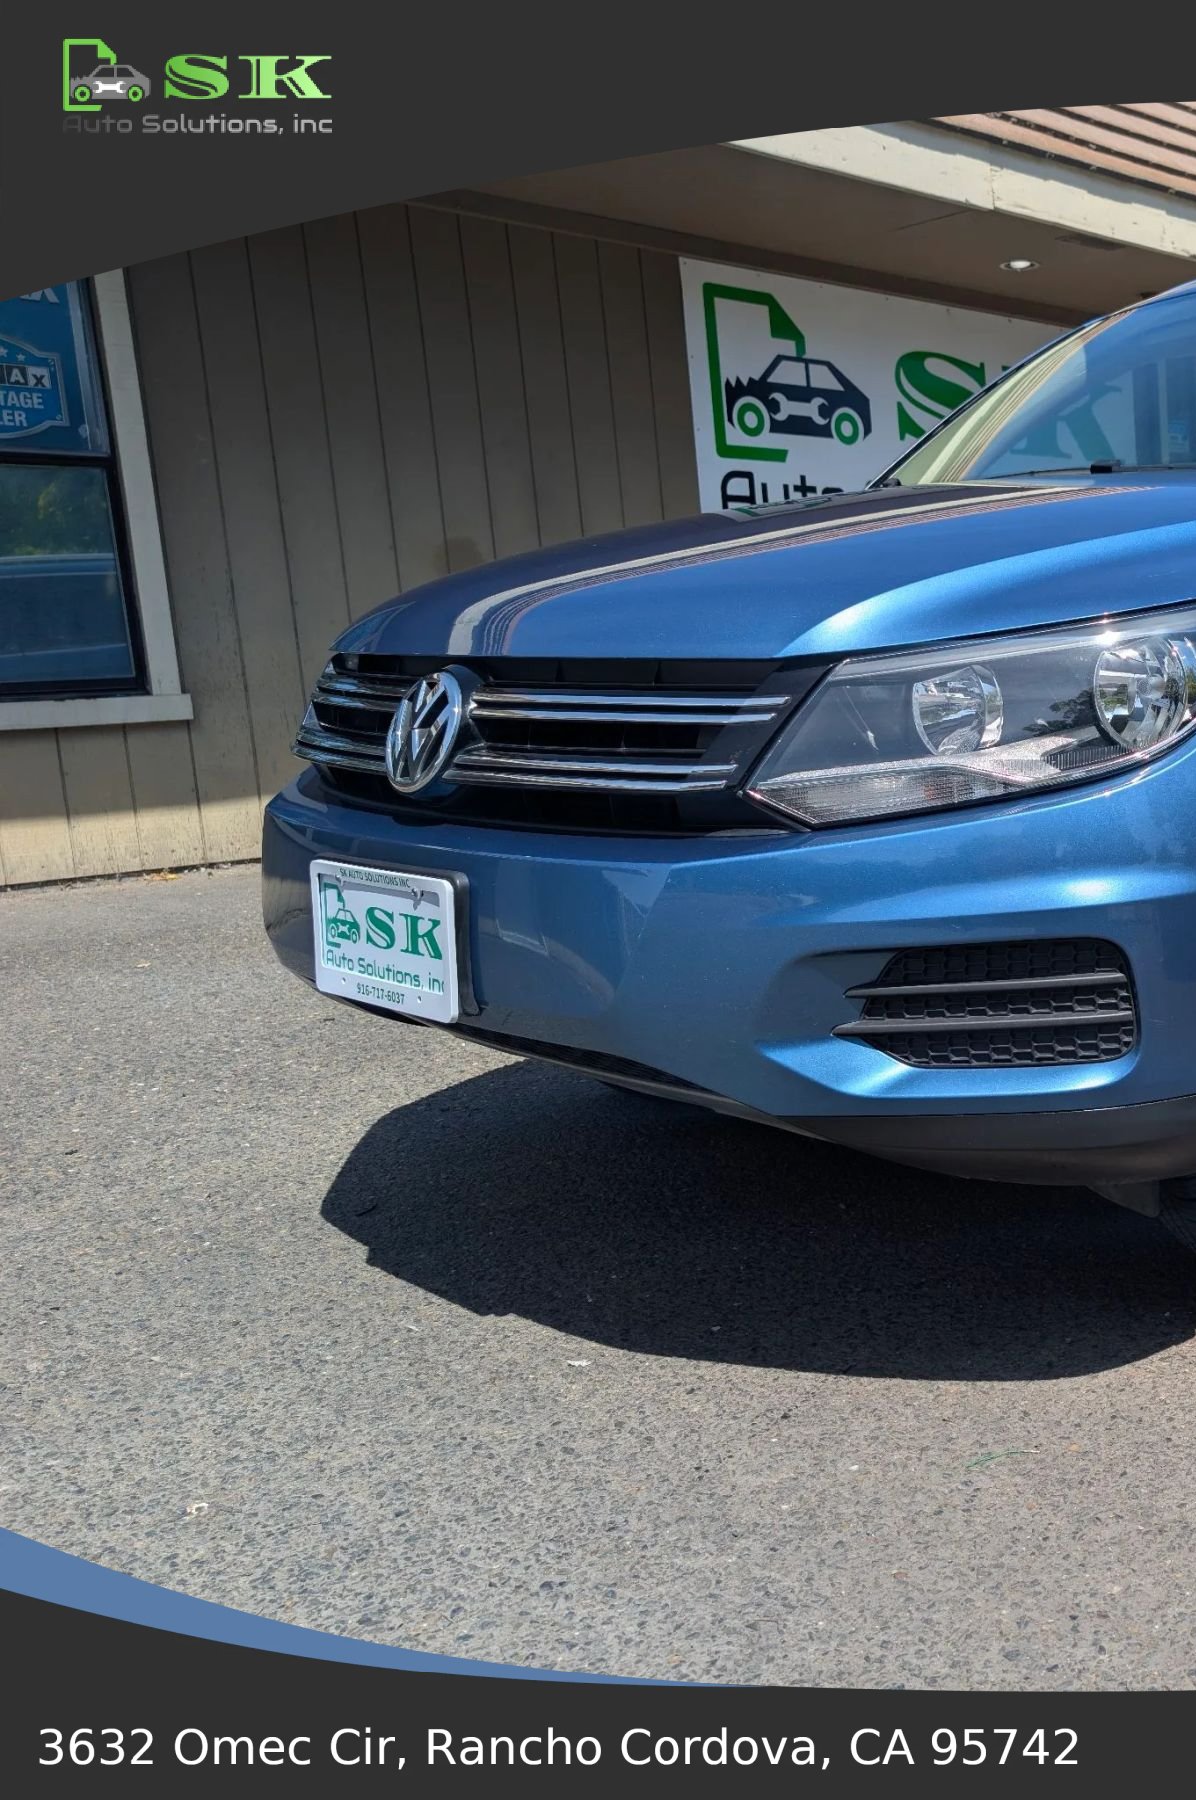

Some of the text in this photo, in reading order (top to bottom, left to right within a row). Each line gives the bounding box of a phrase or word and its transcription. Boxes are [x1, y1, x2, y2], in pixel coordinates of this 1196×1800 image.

[721, 470, 844, 510] Aut
[366, 906, 443, 960] SK
[326, 949, 355, 972] Auto
[356, 982, 405, 1005] 916-717-6037
